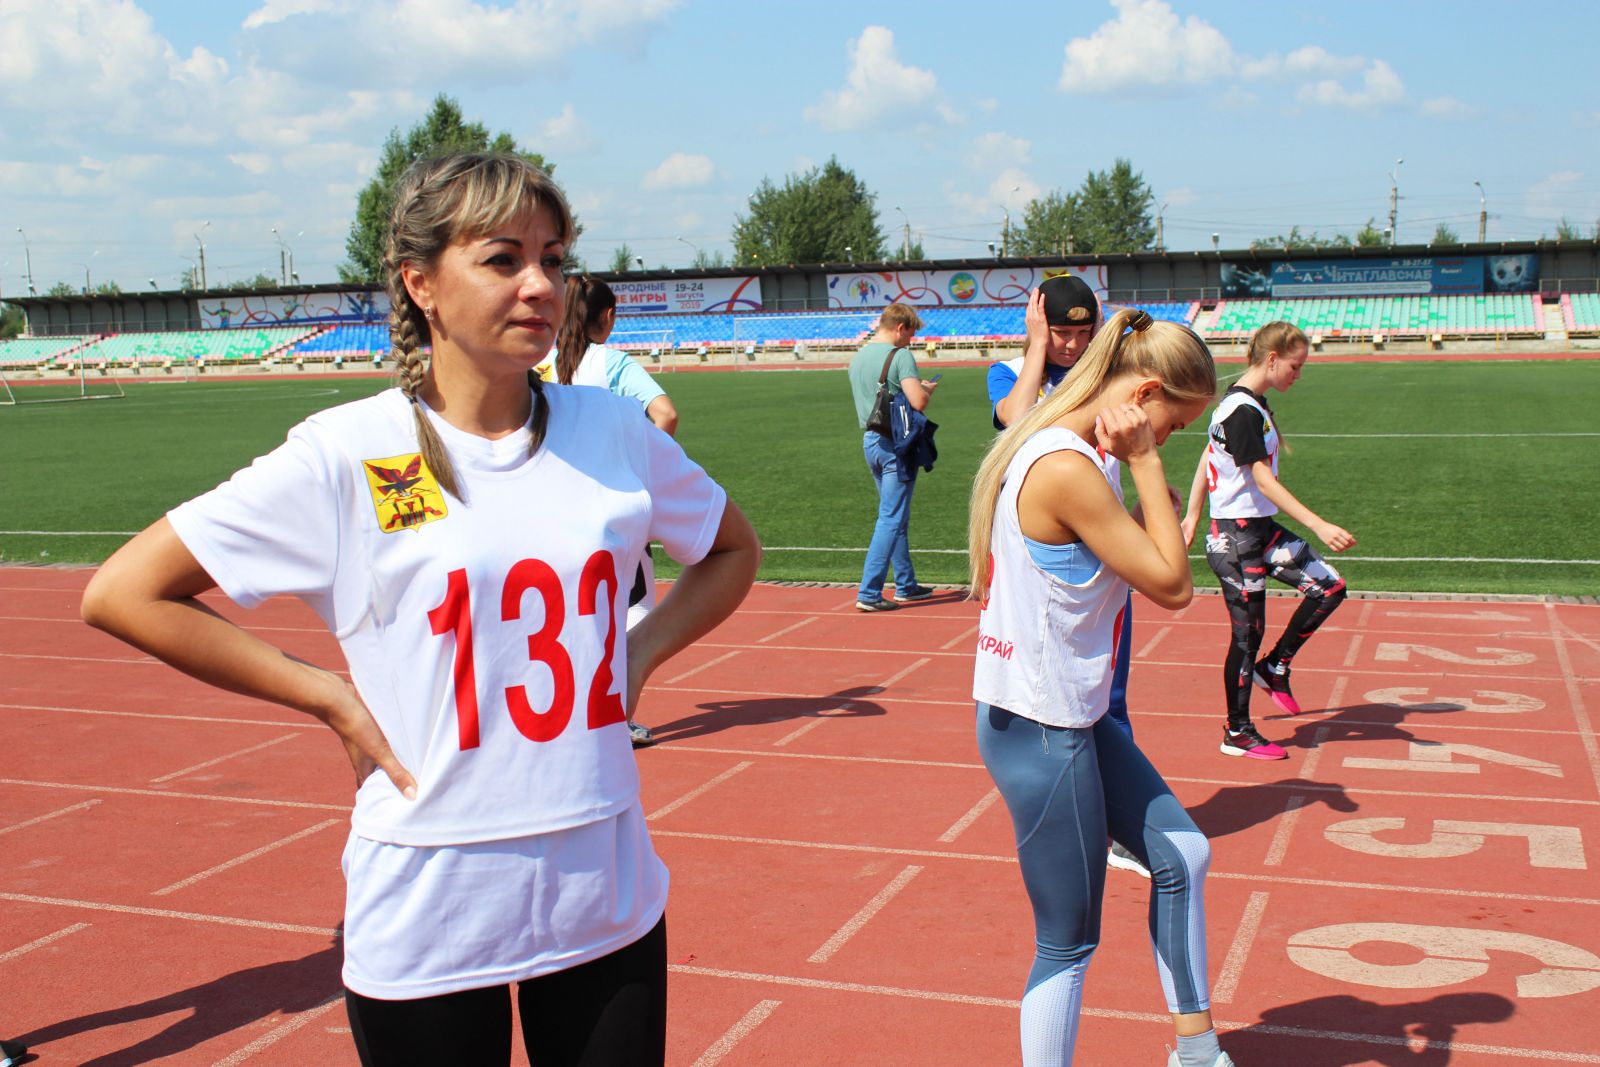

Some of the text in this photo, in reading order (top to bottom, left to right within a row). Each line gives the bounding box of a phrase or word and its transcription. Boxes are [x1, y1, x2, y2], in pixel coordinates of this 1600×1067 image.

[630, 293, 667, 304] ИГРЫ
[675, 282, 703, 292] 19-24
[427, 549, 627, 752] 132
[1374, 642, 1536, 666] 2
[1363, 686, 1547, 714] 3
[1342, 741, 1564, 778] 4
[1323, 816, 1588, 870] 5
[1286, 922, 1600, 999] 6
